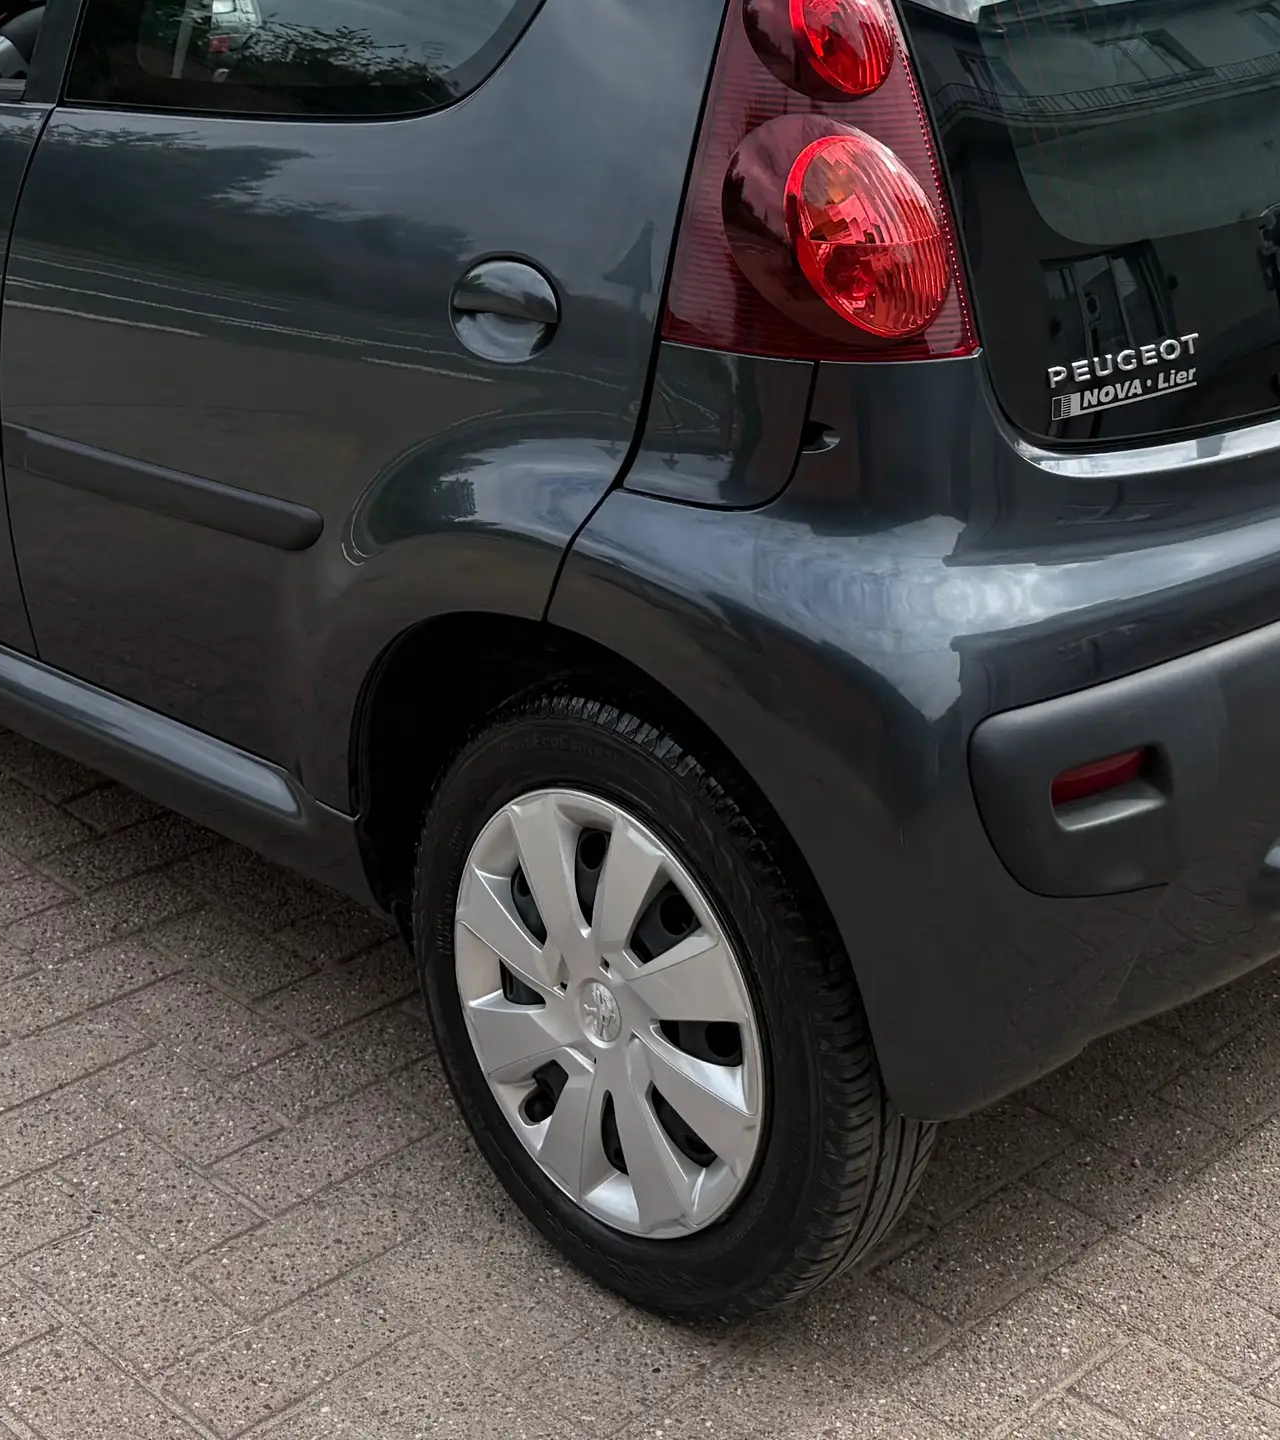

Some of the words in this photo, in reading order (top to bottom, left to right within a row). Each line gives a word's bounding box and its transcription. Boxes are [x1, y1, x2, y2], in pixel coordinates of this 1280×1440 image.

[1047, 332, 1199, 389] PEUGEOT
[1082, 378, 1142, 408] NOVA
[1157, 367, 1196, 389] Lier
